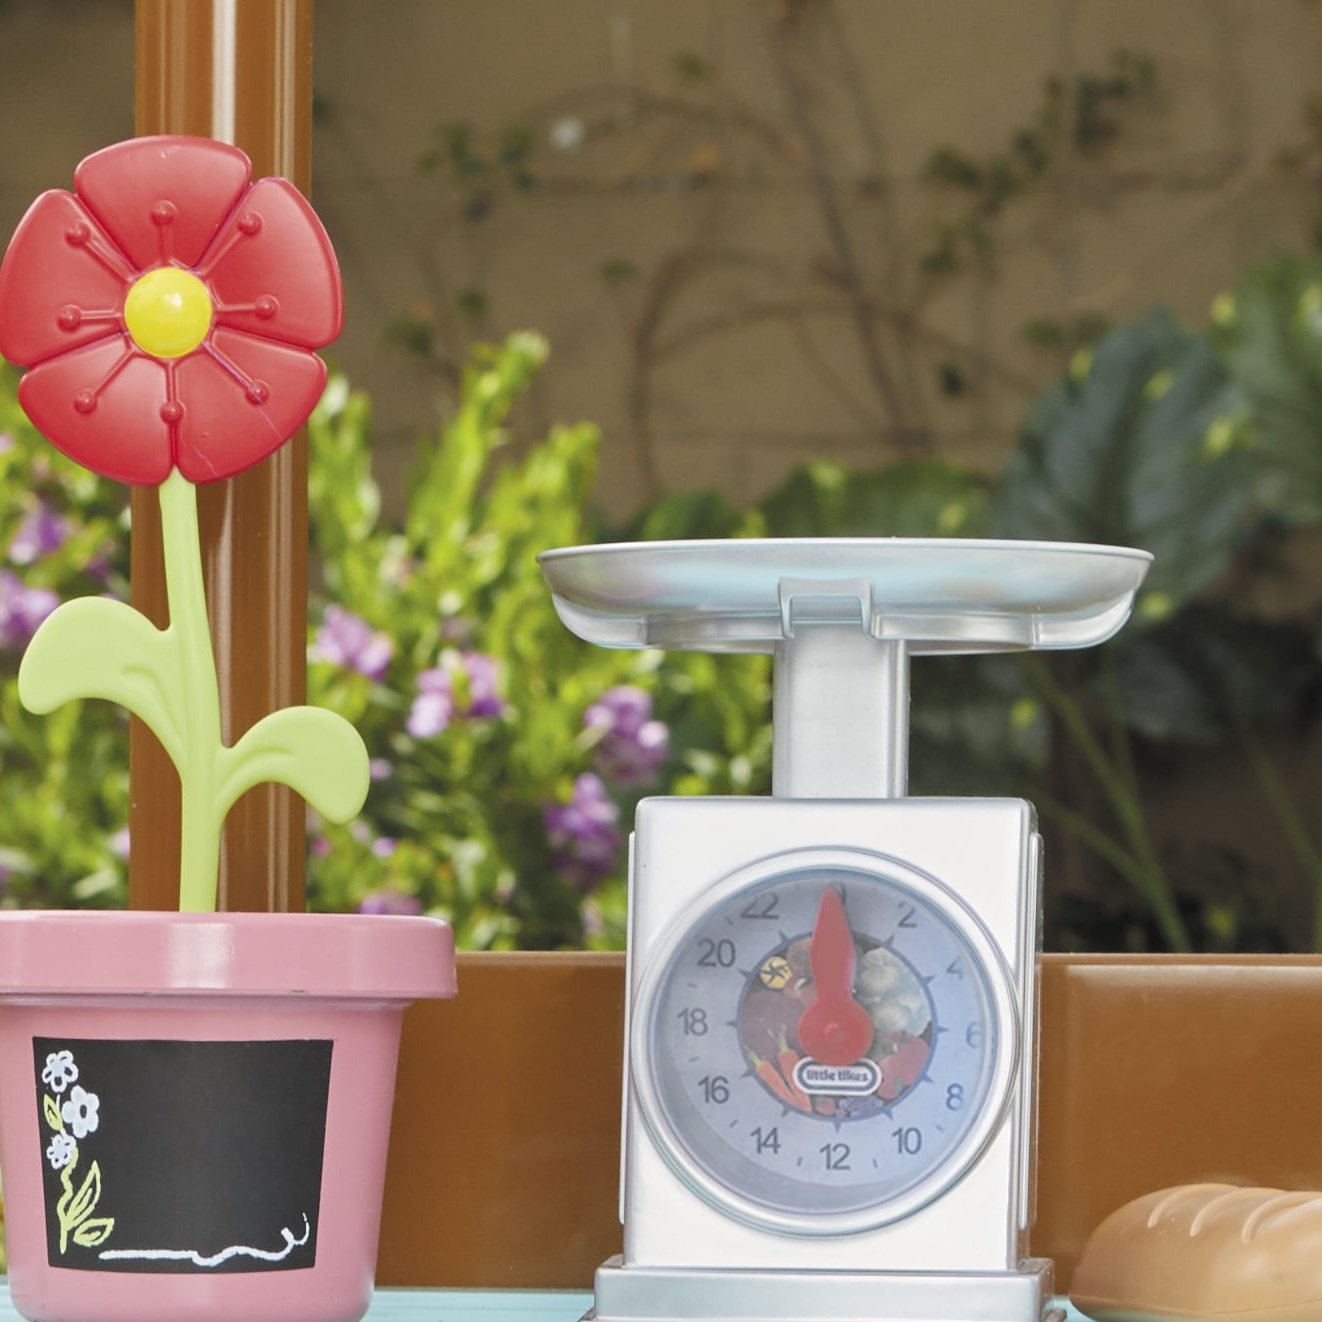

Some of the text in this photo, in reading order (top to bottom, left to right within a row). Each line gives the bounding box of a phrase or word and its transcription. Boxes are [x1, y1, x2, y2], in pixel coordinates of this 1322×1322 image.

[741, 890, 780, 920] 22
[898, 902, 918, 929] 2
[697, 938, 736, 968] 20
[945, 958, 965, 982] 4
[677, 1008, 709, 1037] 18
[965, 1022, 983, 1049] 6
[805, 1068, 836, 1081] little
[698, 1075, 730, 1104] 16
[945, 1084, 964, 1111] 8
[750, 1126, 781, 1155] 14
[891, 1127, 922, 1155] 10
[819, 1143, 851, 1171] 12
